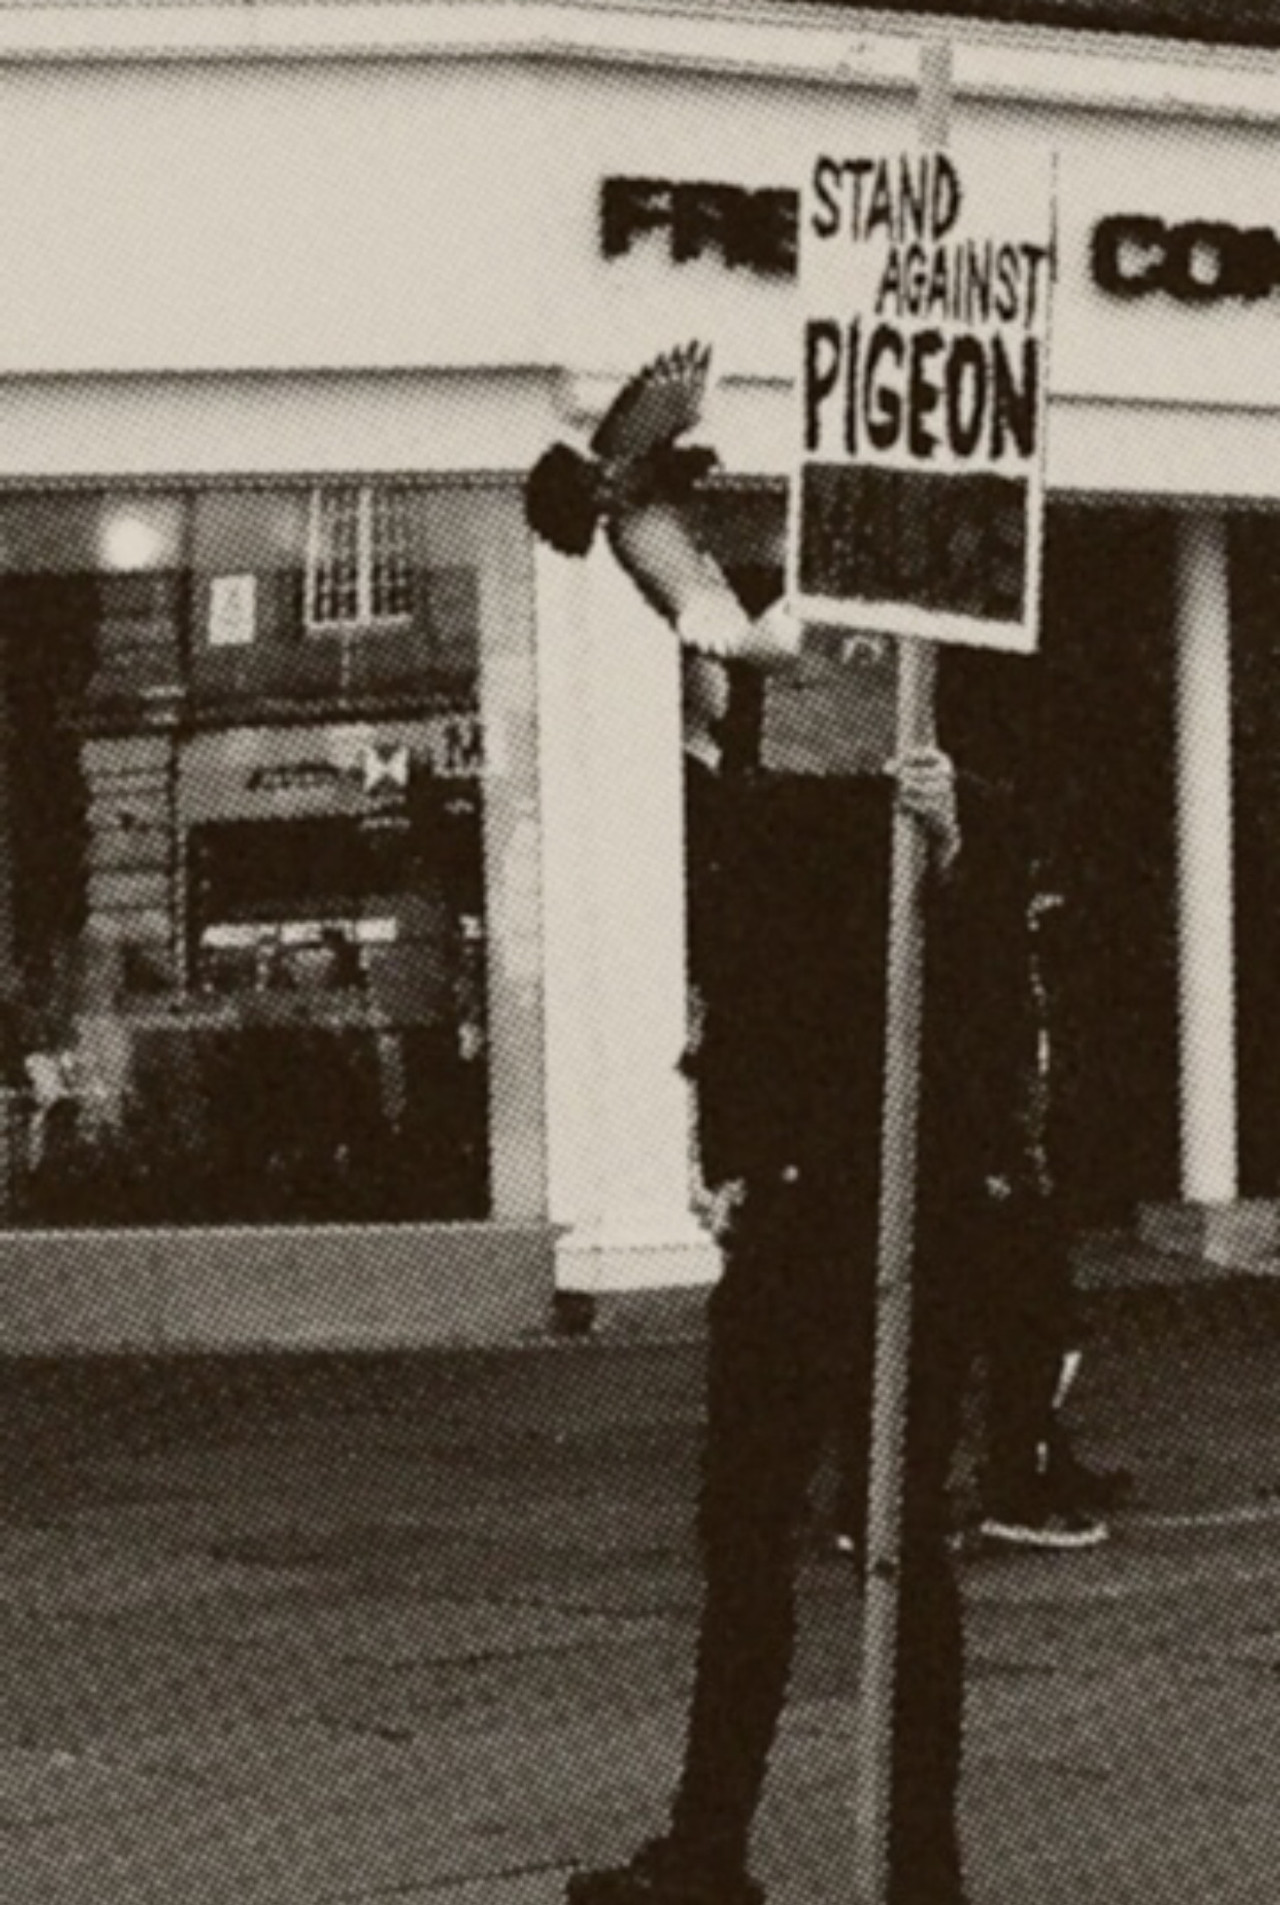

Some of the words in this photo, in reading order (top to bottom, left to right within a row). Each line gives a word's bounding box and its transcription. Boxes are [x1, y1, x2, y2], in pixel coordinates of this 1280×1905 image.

[811, 154, 961, 240] STAND
[875, 241, 1050, 328] AGAINST
[805, 316, 1037, 459] PIGEON
